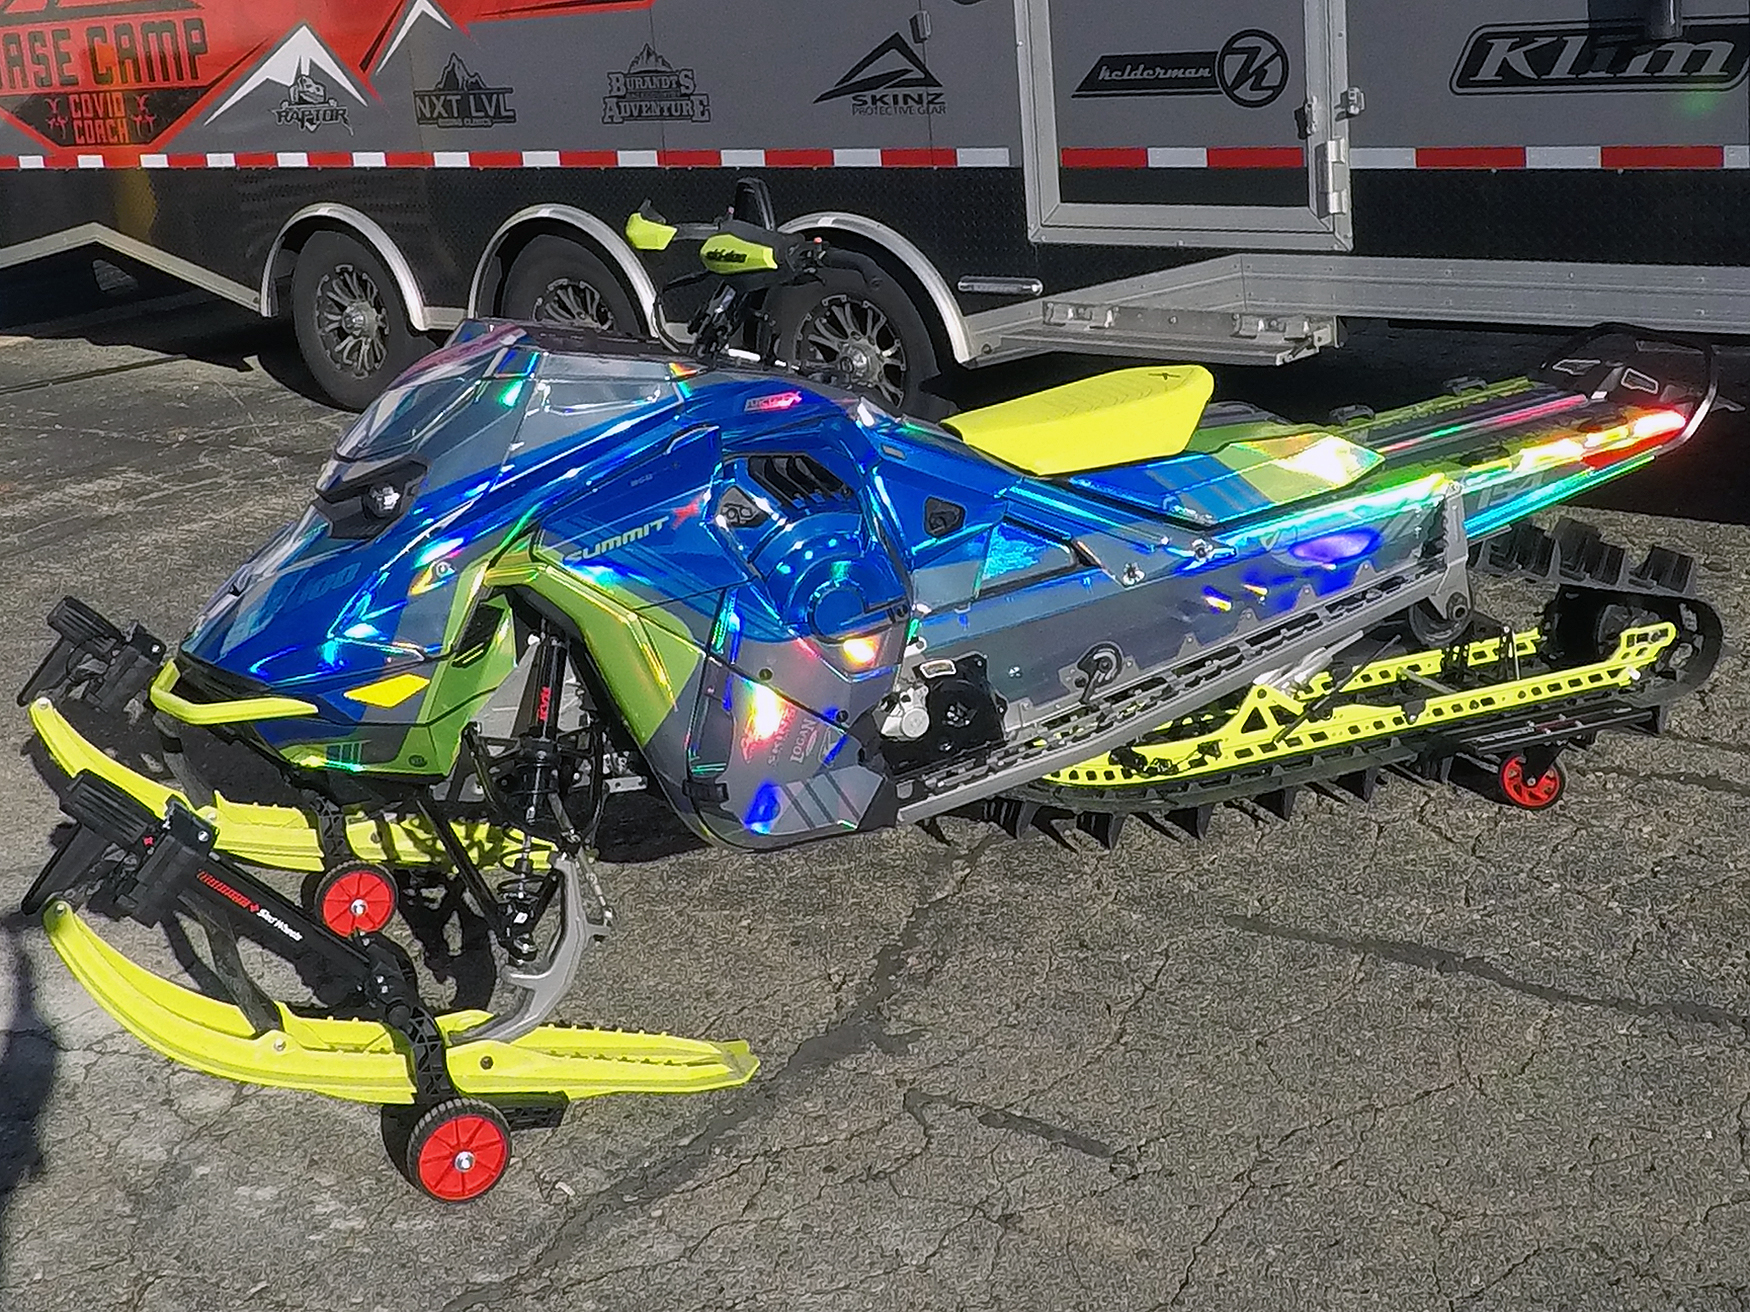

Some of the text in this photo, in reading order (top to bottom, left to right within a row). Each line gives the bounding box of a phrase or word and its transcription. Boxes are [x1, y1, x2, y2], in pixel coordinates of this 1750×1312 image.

[0, 18, 208, 89] ASE CAMP
[69, 92, 127, 118] COVID
[415, 93, 516, 118] NXT LVL
[602, 94, 711, 124] ADVENTURE
[852, 92, 946, 106] SKINZ
[72, 117, 131, 144] COACH
[271, 106, 352, 135] RAPTOR
[564, 515, 670, 561] SUMMIT
[790, 718, 817, 763] LOGAN
